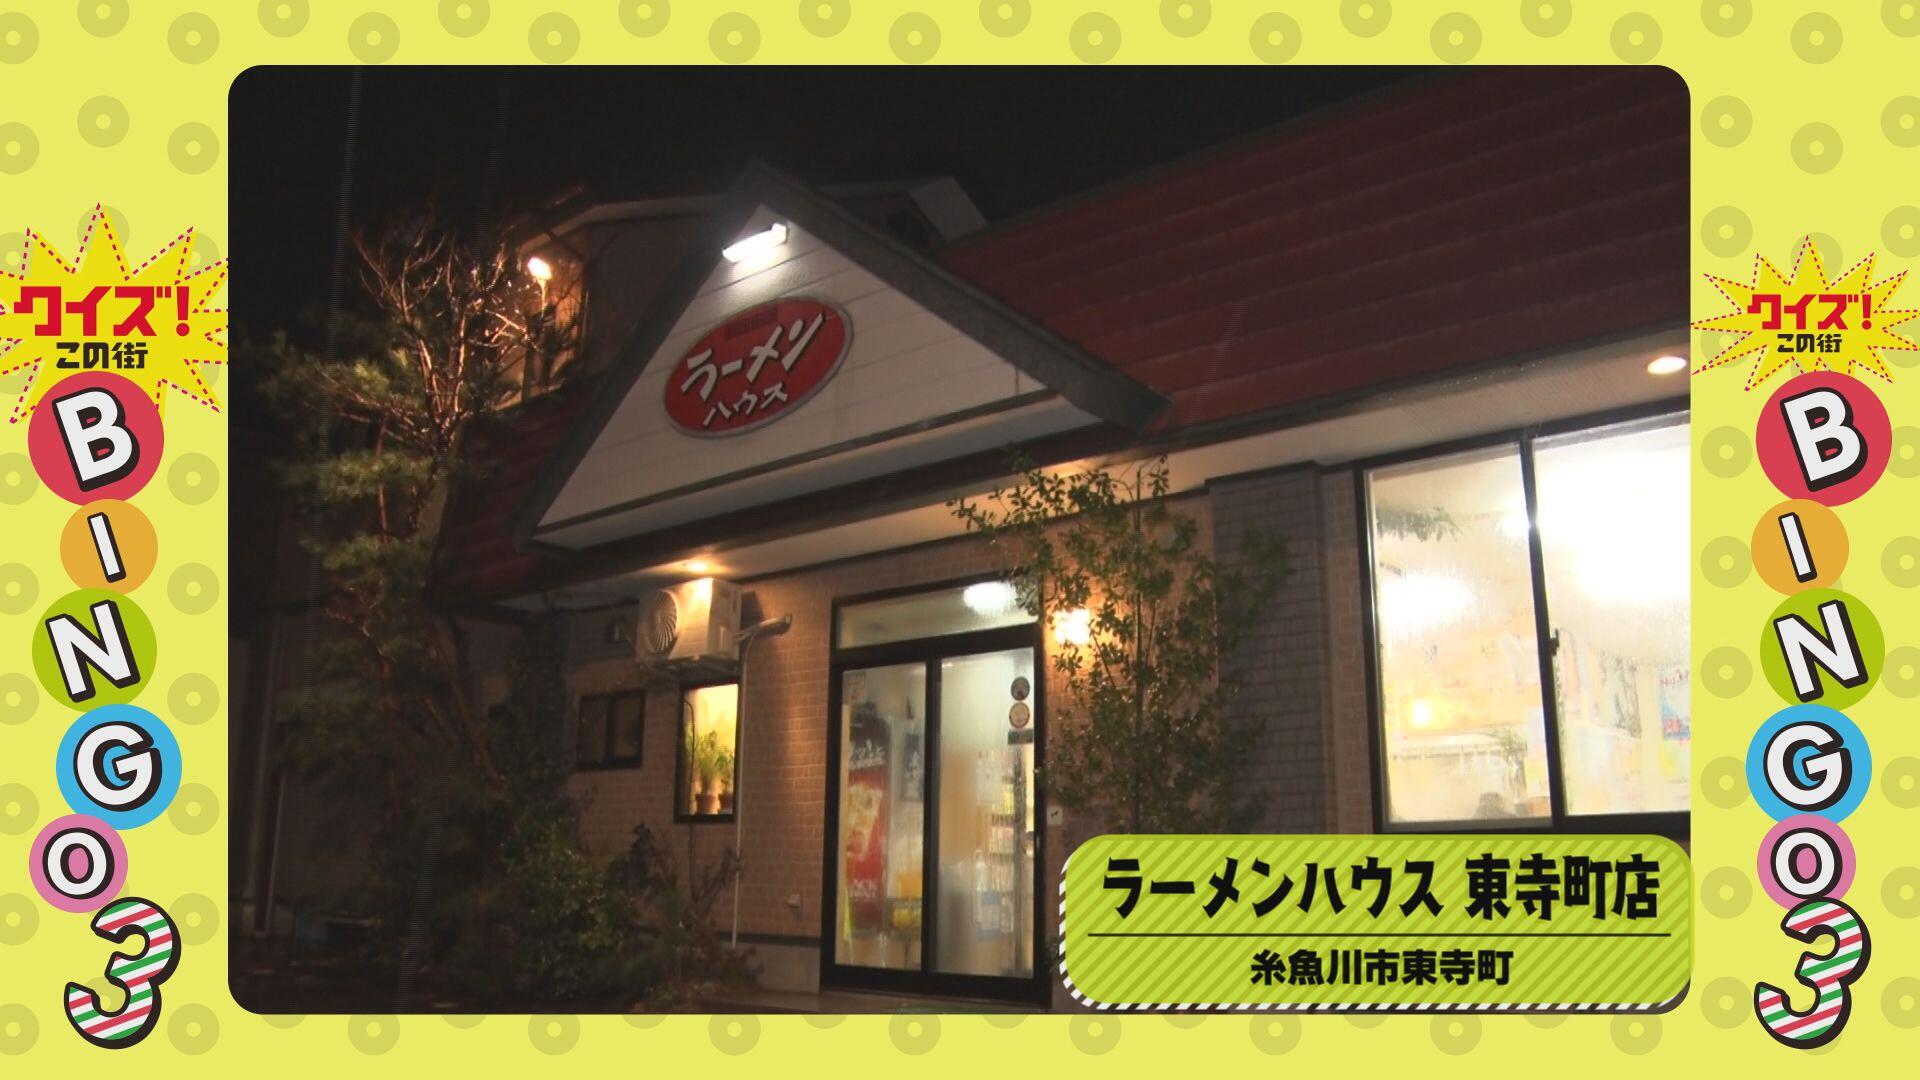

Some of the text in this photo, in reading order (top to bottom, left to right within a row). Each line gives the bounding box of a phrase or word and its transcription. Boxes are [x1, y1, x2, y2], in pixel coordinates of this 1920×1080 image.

[680, 313, 826, 401] ラーメン
[703, 381, 788, 427] ハウス
